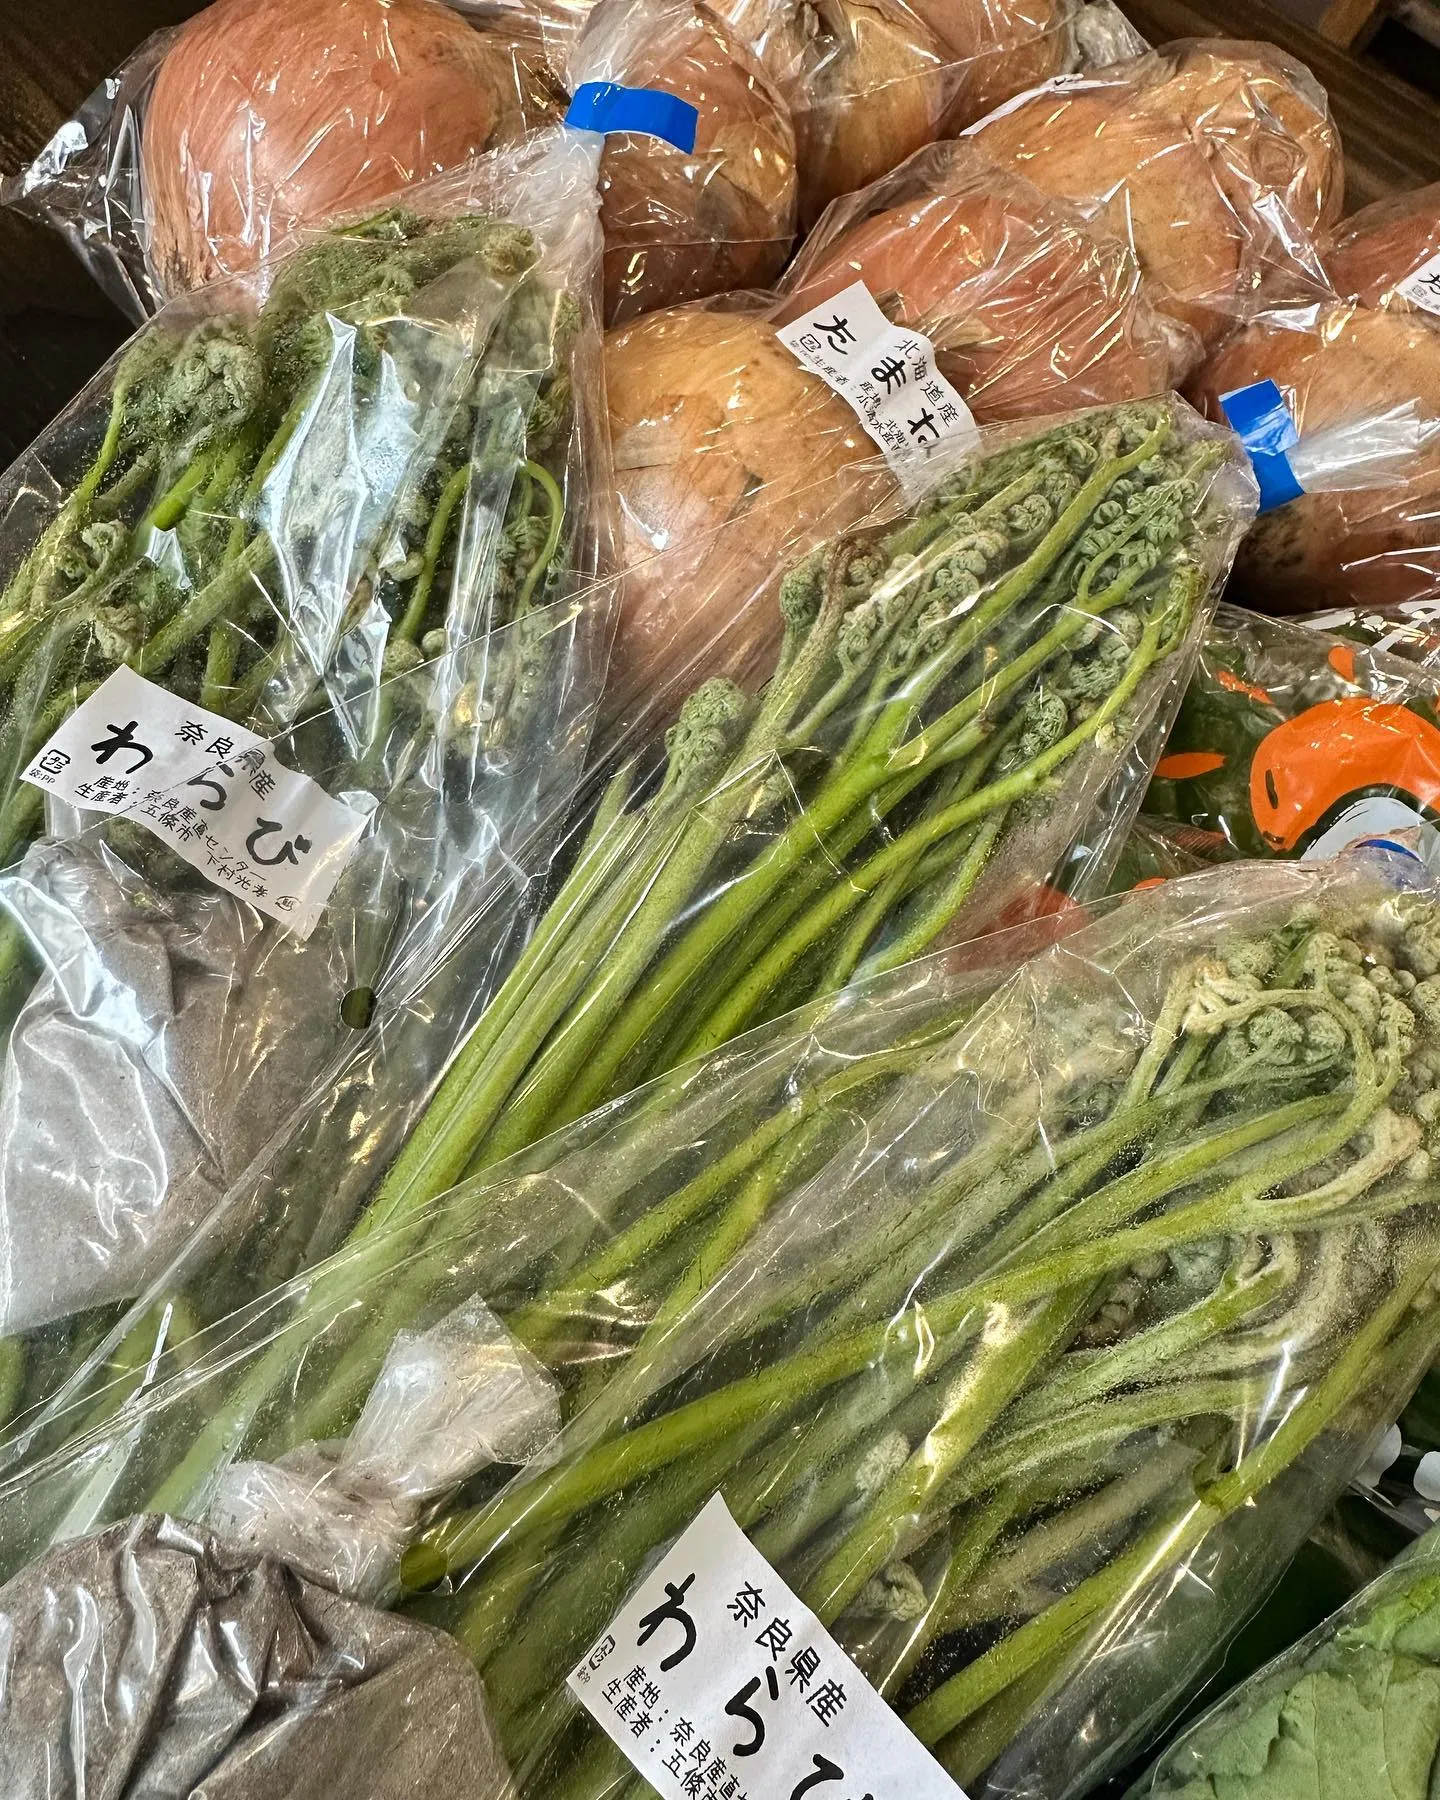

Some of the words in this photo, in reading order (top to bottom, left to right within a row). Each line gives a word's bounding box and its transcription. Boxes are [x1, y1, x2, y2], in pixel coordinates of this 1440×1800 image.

[894, 338, 960, 428] 北海道産
[91, 720, 313, 865] わらび
[174, 720, 277, 801] 奈良県産
[727, 1581, 848, 1728] 奈良県産
